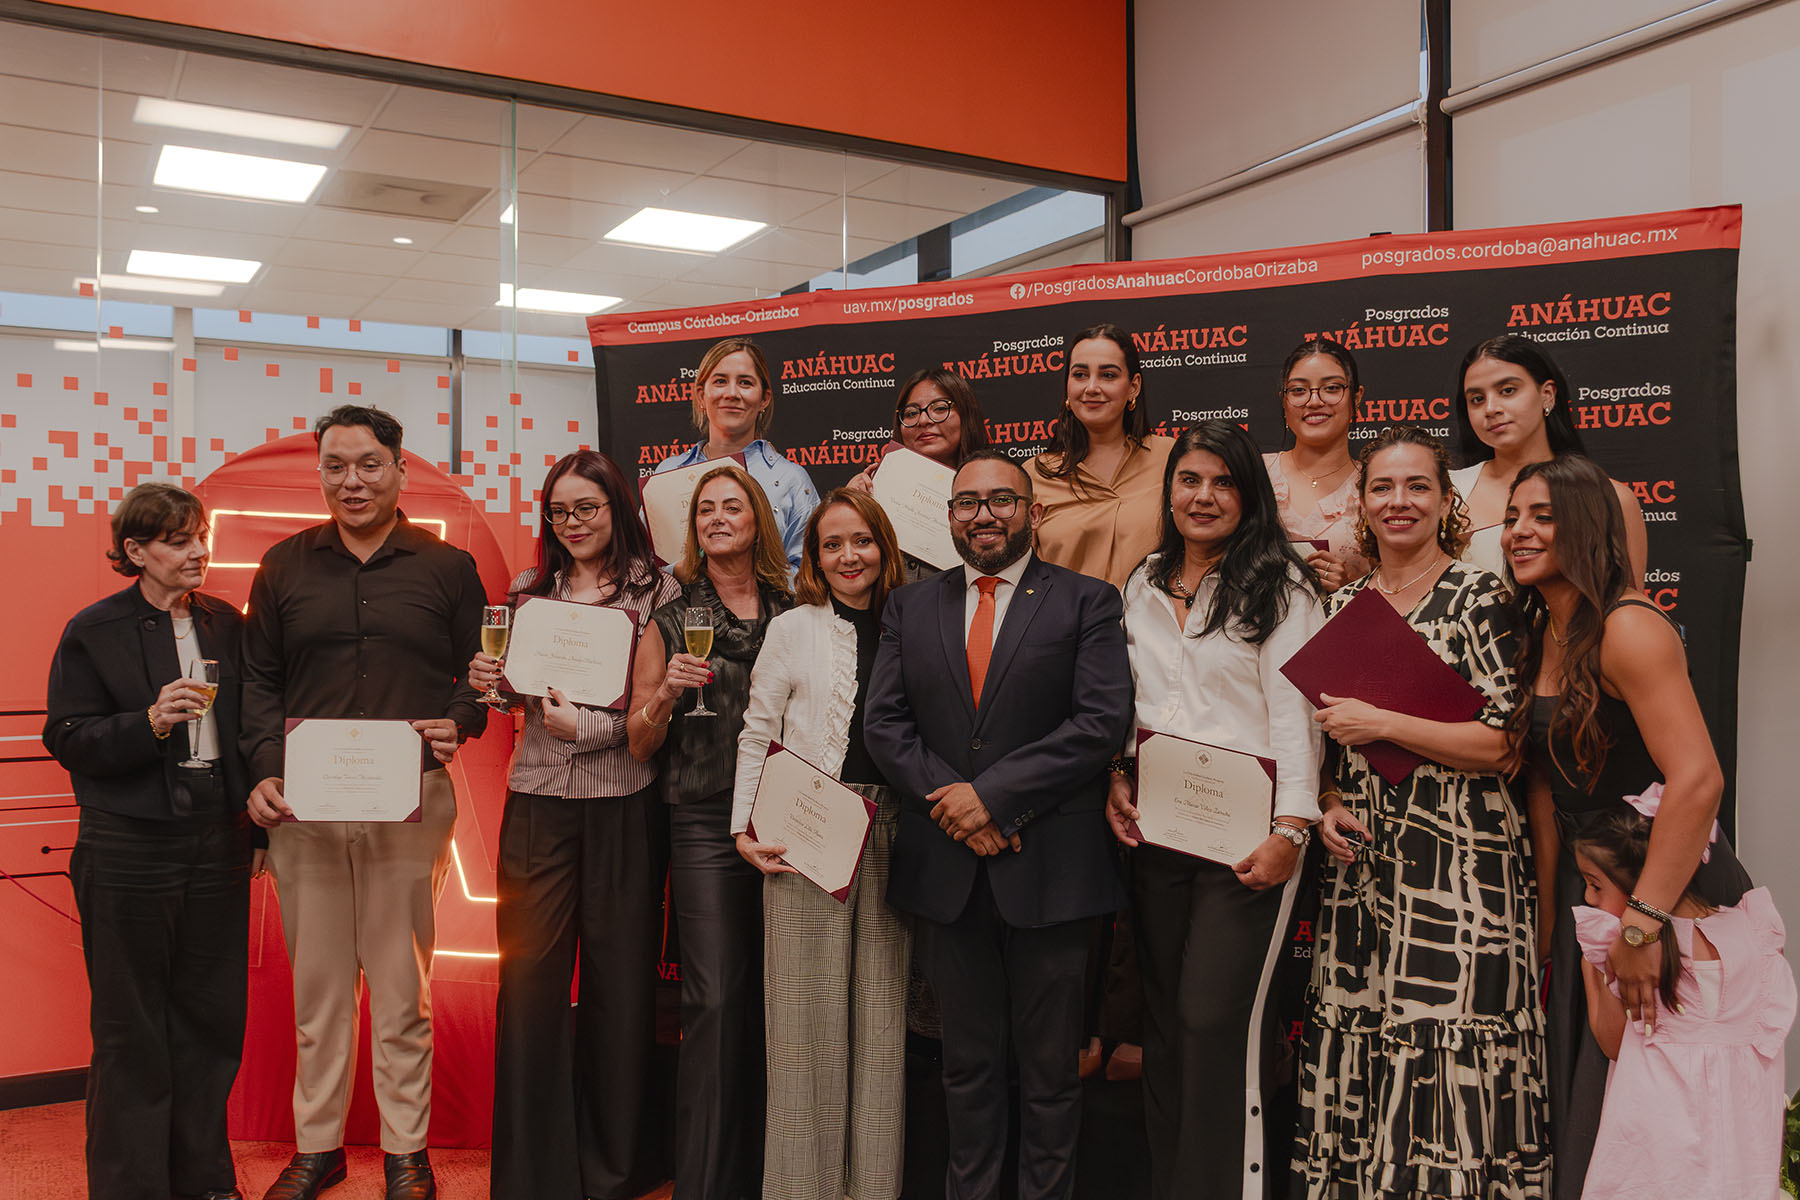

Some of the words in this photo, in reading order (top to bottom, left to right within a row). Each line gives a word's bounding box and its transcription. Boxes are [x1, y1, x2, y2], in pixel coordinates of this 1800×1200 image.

[1362, 226, 1679, 269] posgrados.cordoba@anahuac.mx
[843, 292, 974, 314] uav.mx/posgrados
[1506, 292, 1672, 327] ANÁHUAC
[627, 320, 682, 334] Campus
[683, 306, 800, 329] Córdoba-Orizaba
[1365, 305, 1449, 323] Posgrados
[1594, 322, 1669, 339] Continua
[993, 335, 1064, 353] Posgrados
[781, 350, 896, 380] ANÁHUAC
[1184, 352, 1247, 366] Continua
[782, 379, 841, 394] Educación
[843, 377, 895, 390] Continua
[1578, 382, 1671, 401] Posgrados
[832, 427, 894, 443] Posgrados
[912, 488, 946, 512] Diploma
[553, 634, 588, 649] Diploma
[333, 754, 375, 767] Diploma
[1183, 779, 1224, 799] Diploma
[795, 797, 827, 824] Diploma
